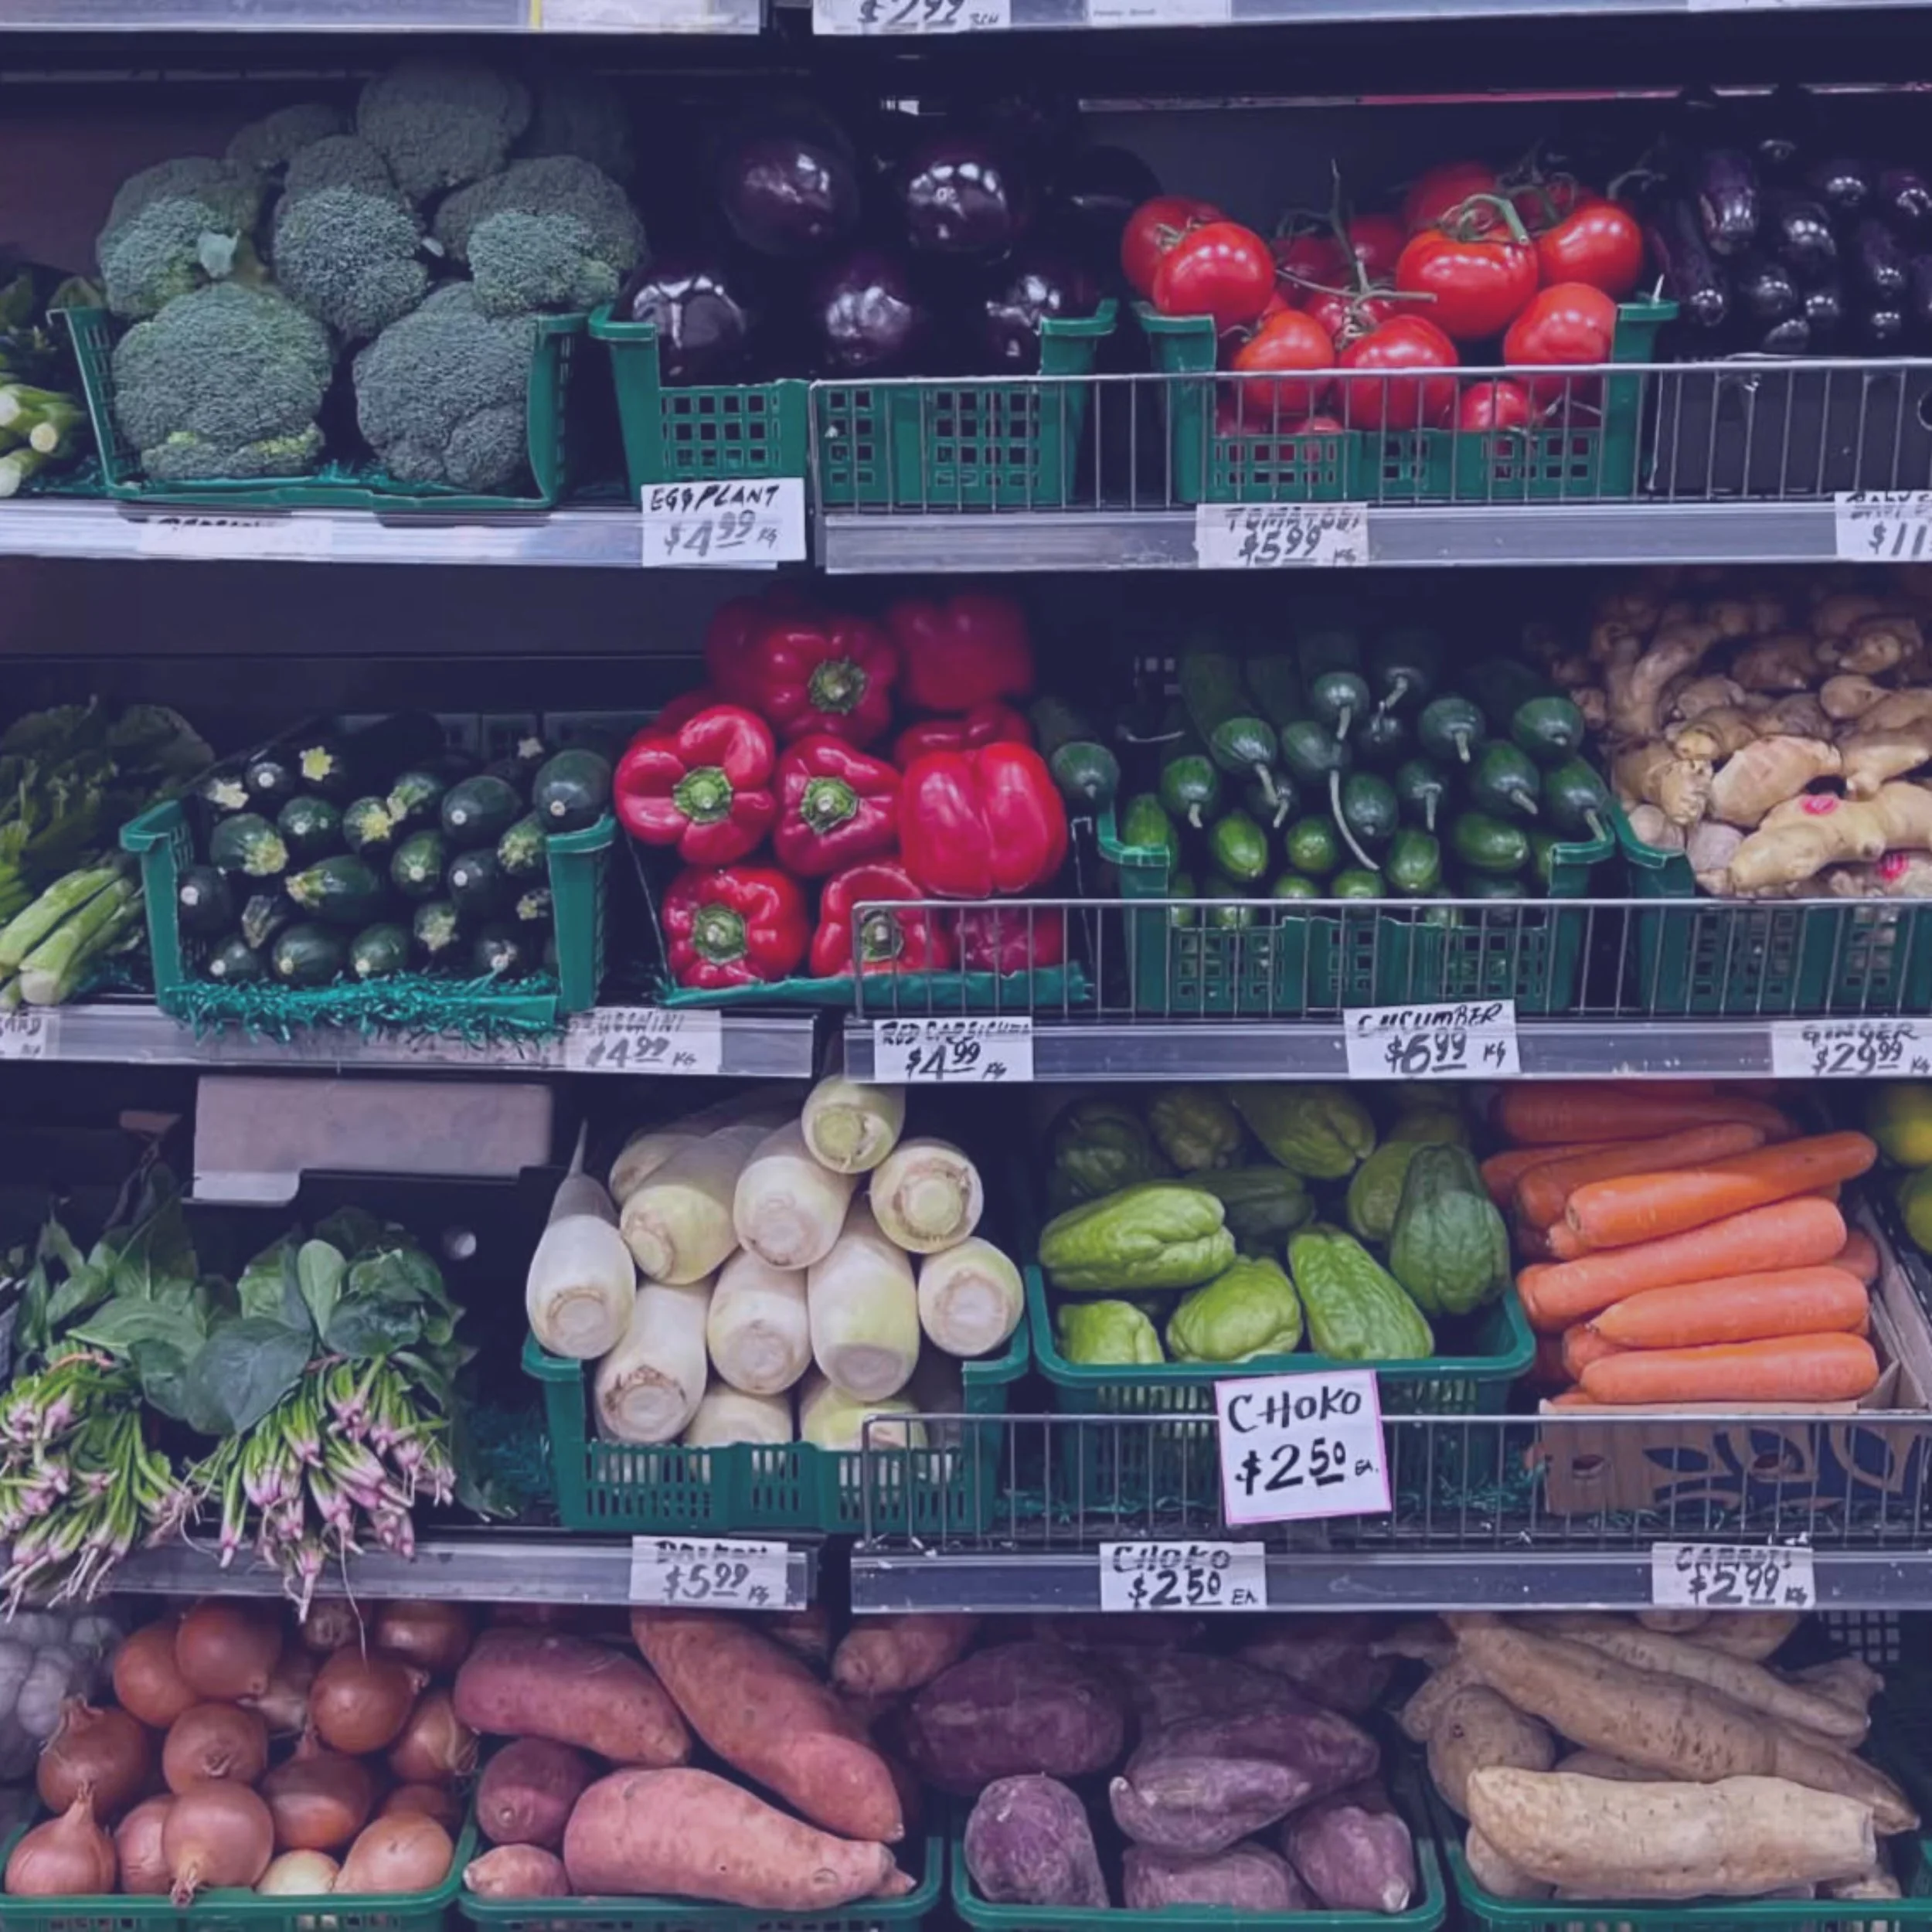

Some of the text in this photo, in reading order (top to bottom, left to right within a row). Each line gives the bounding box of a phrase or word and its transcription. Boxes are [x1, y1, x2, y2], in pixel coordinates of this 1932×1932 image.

[651, 484, 780, 512] EGGPLANT
[1228, 1385, 1362, 1433] CHOKO
[1113, 1545, 1231, 1573] CHOKO
